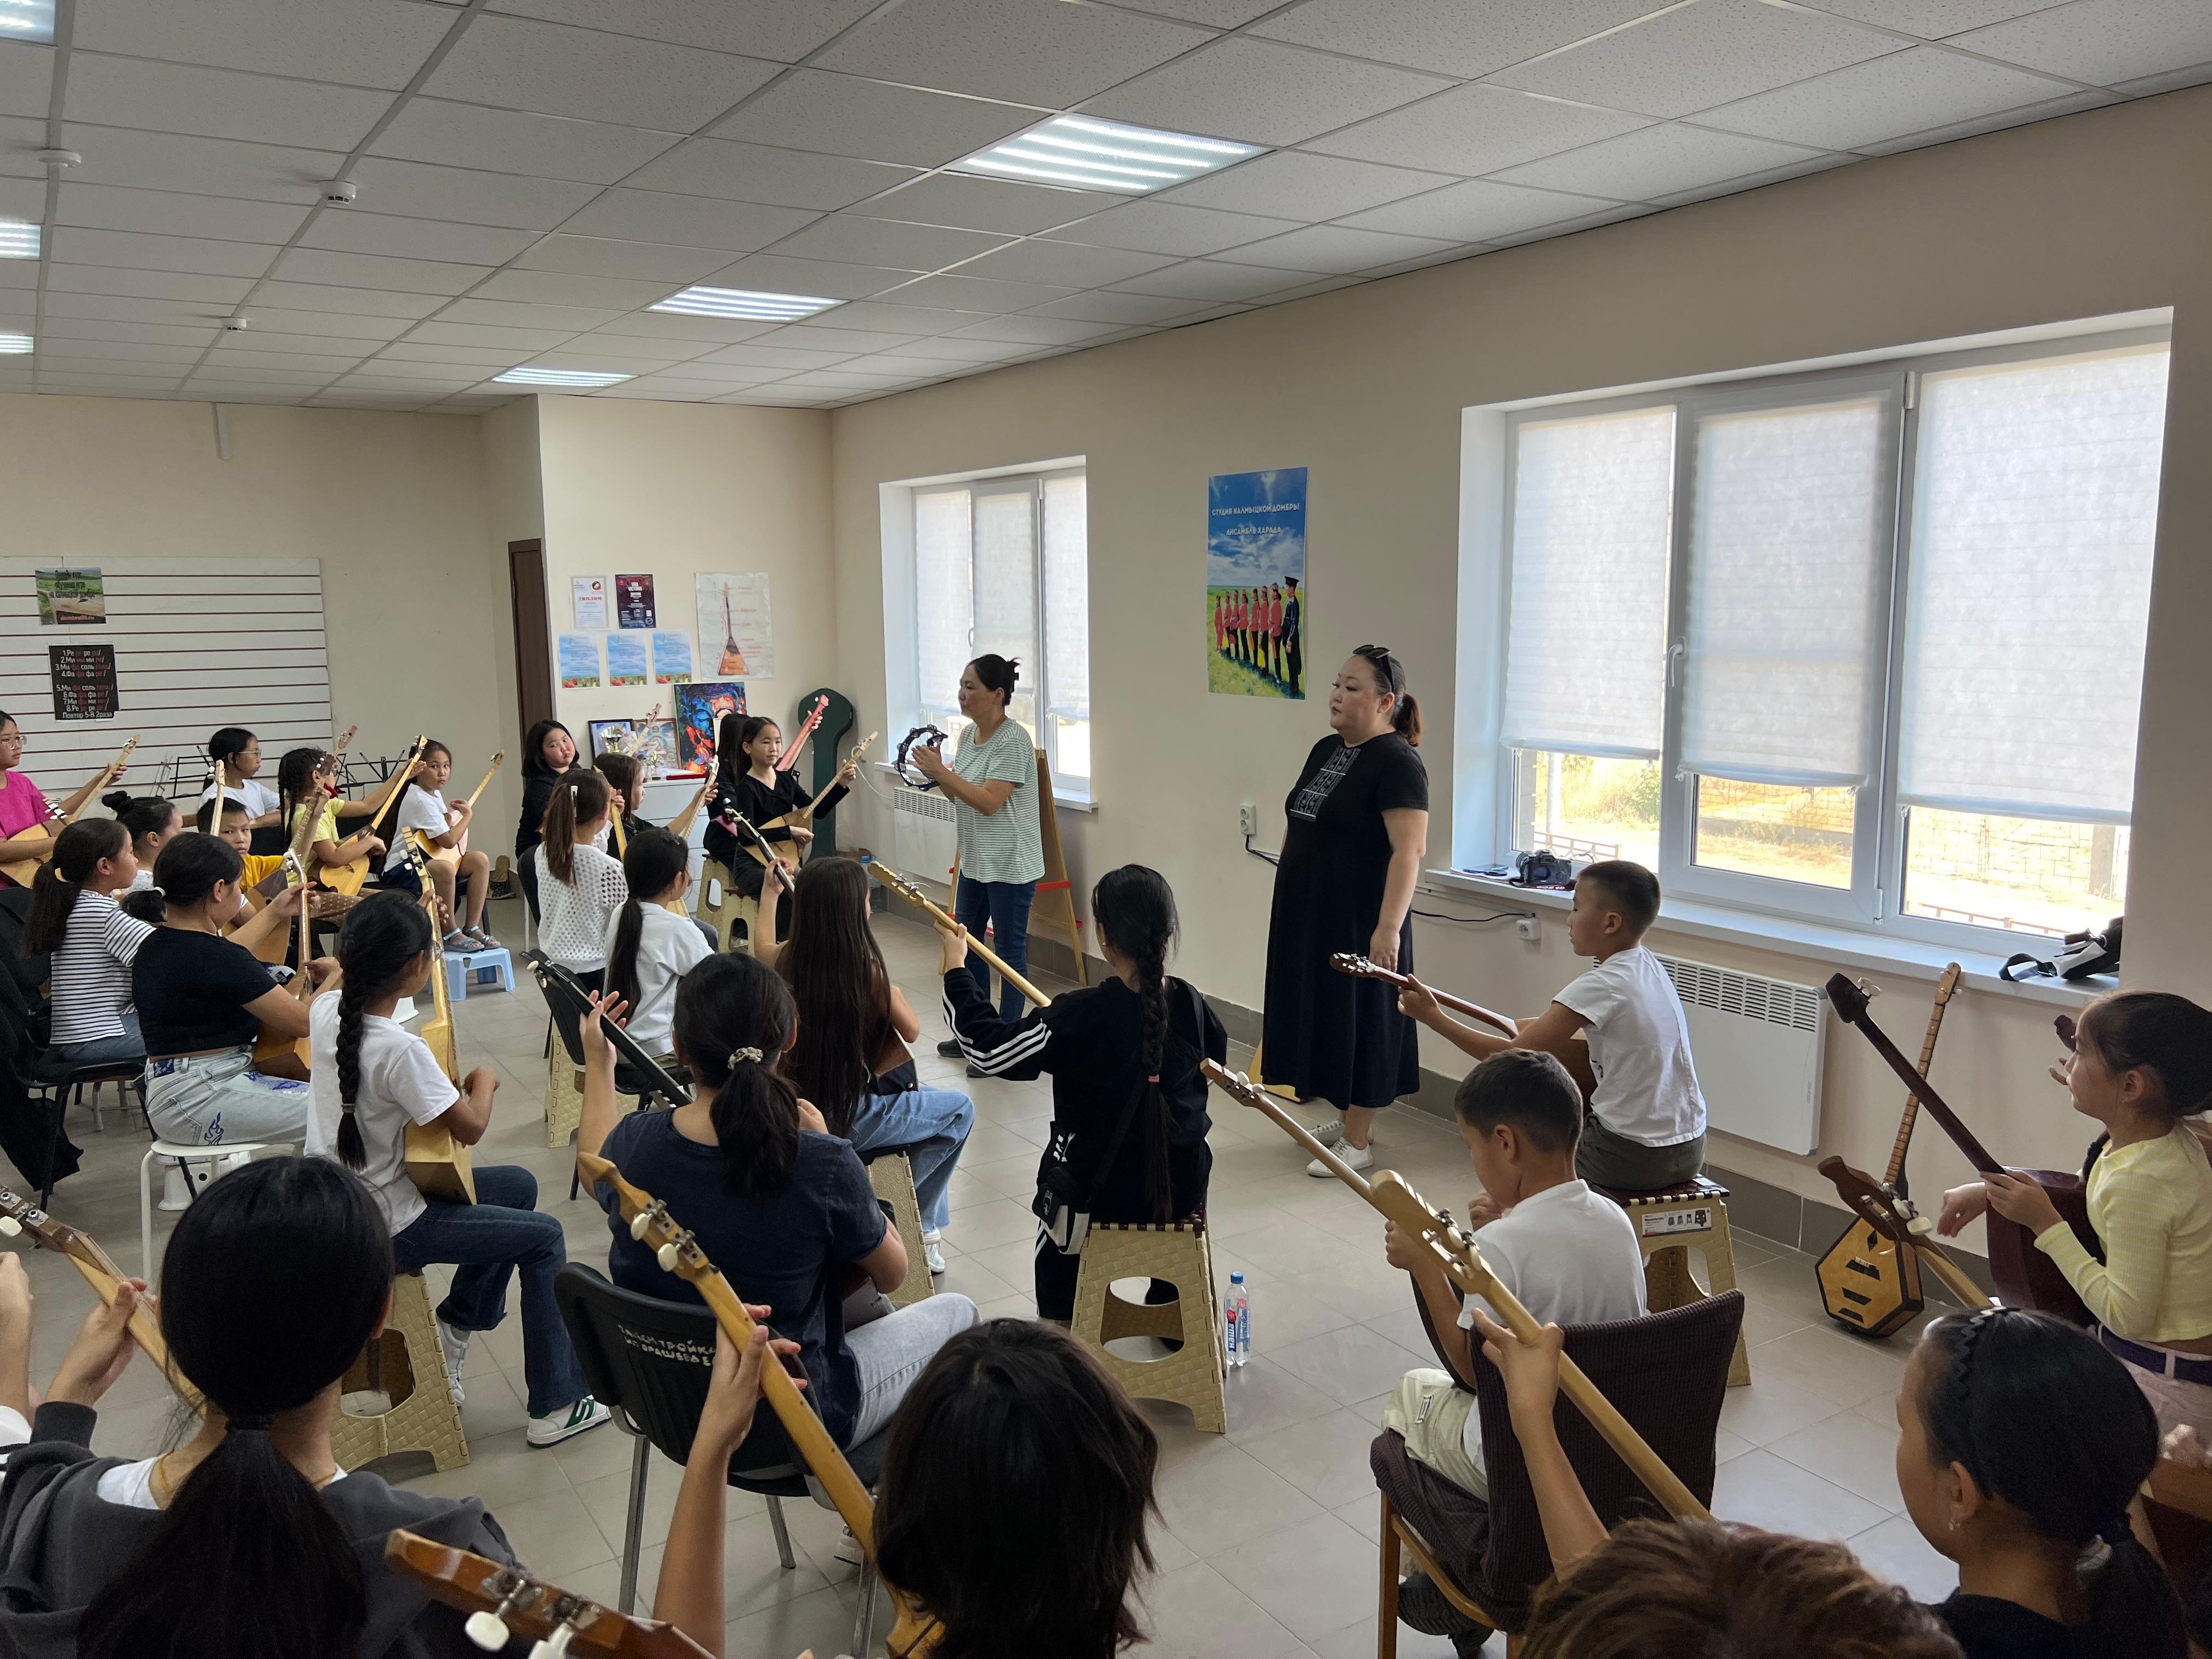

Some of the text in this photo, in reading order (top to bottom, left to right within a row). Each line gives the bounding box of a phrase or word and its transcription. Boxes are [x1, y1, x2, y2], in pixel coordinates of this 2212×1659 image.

[1212, 503, 1300, 516] СТУДИЯ КАЛМЫЦКОЙ ДОМБРЫ
[1226, 527, 1256, 535] АНСАМБЛЬ
